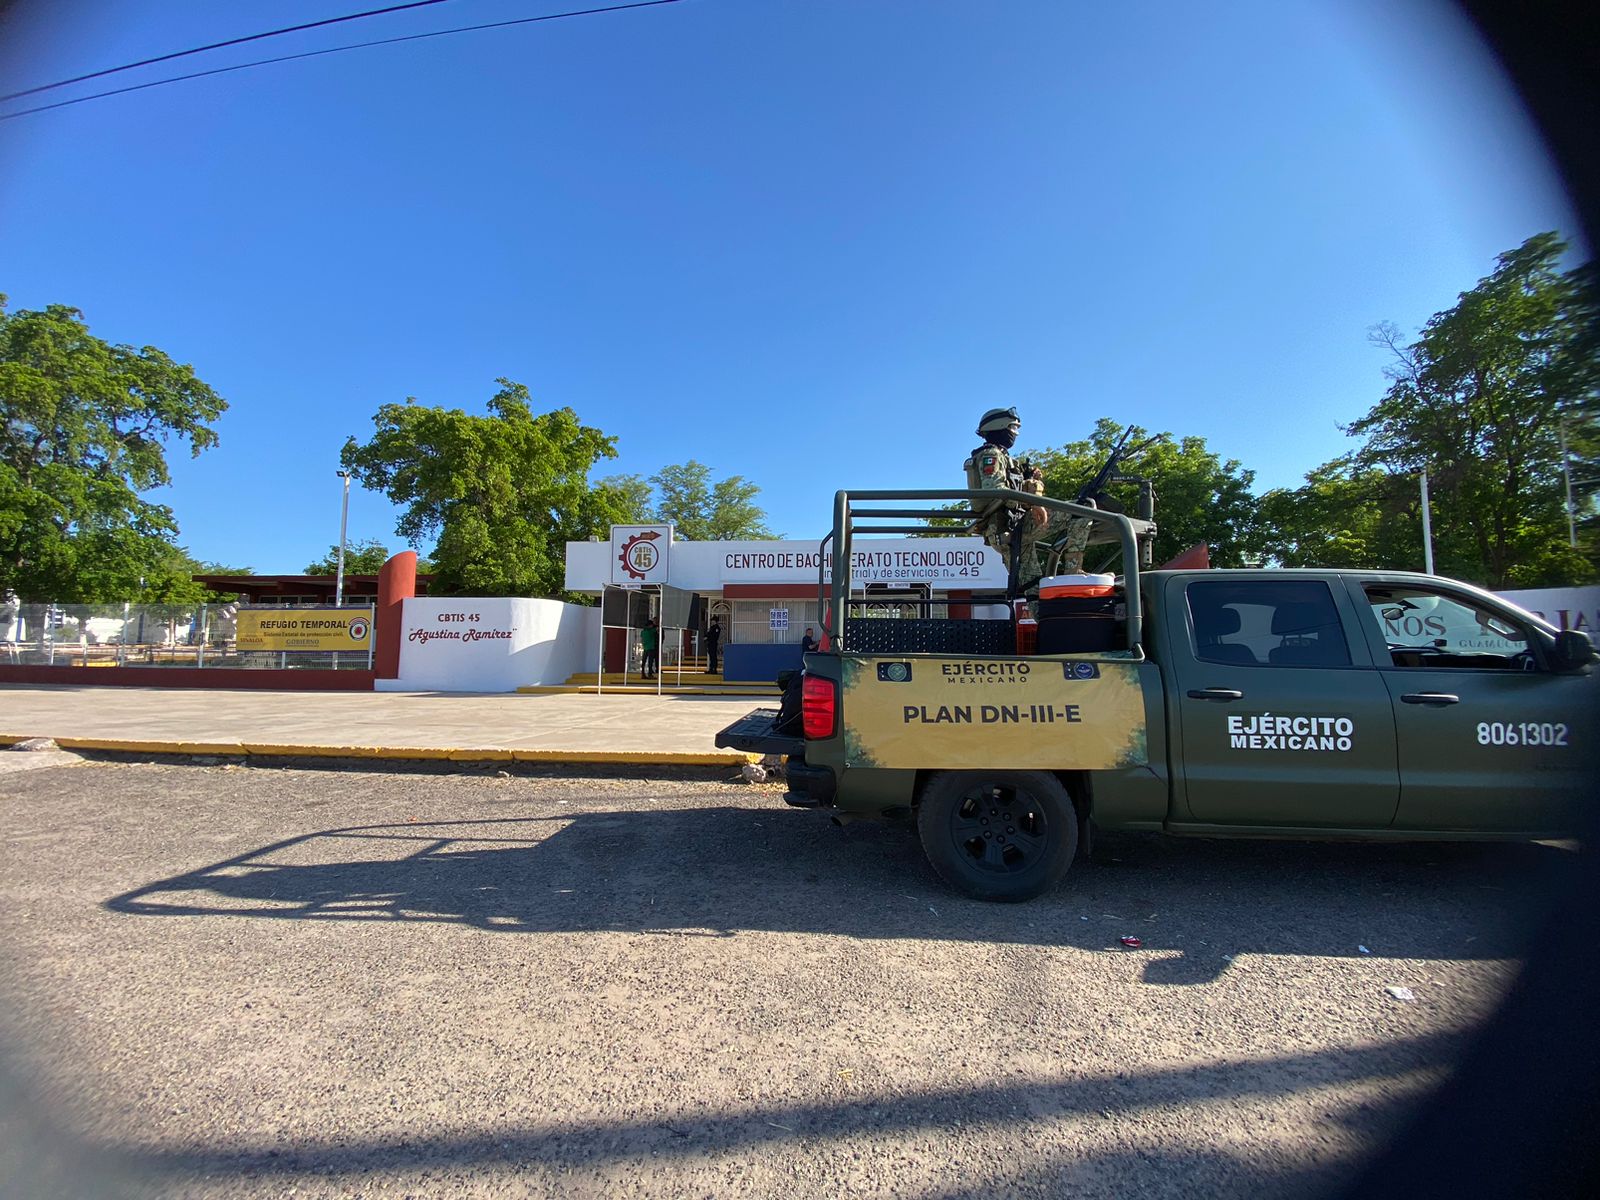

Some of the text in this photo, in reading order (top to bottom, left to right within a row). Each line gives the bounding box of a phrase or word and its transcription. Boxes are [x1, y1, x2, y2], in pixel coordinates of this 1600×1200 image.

[634, 553, 652, 568] 45
[725, 550, 984, 569] CENTRO DE BACHIERATO TECNOLOGICO
[873, 570, 878, 580] y
[881, 568, 893, 578] de
[895, 568, 939, 578] servicios
[959, 566, 980, 577] 45
[260, 620, 348, 629] REFUGIO TEMPORAL
[438, 613, 480, 622] CBTIS 45
[941, 661, 1031, 675] EJÉRCITO
[903, 704, 1082, 724] PLAN DN-III-E
[1227, 712, 1353, 736] EJÉRCITO
[1476, 722, 1568, 746] 8061302
[1230, 735, 1352, 751] MEXICANO
